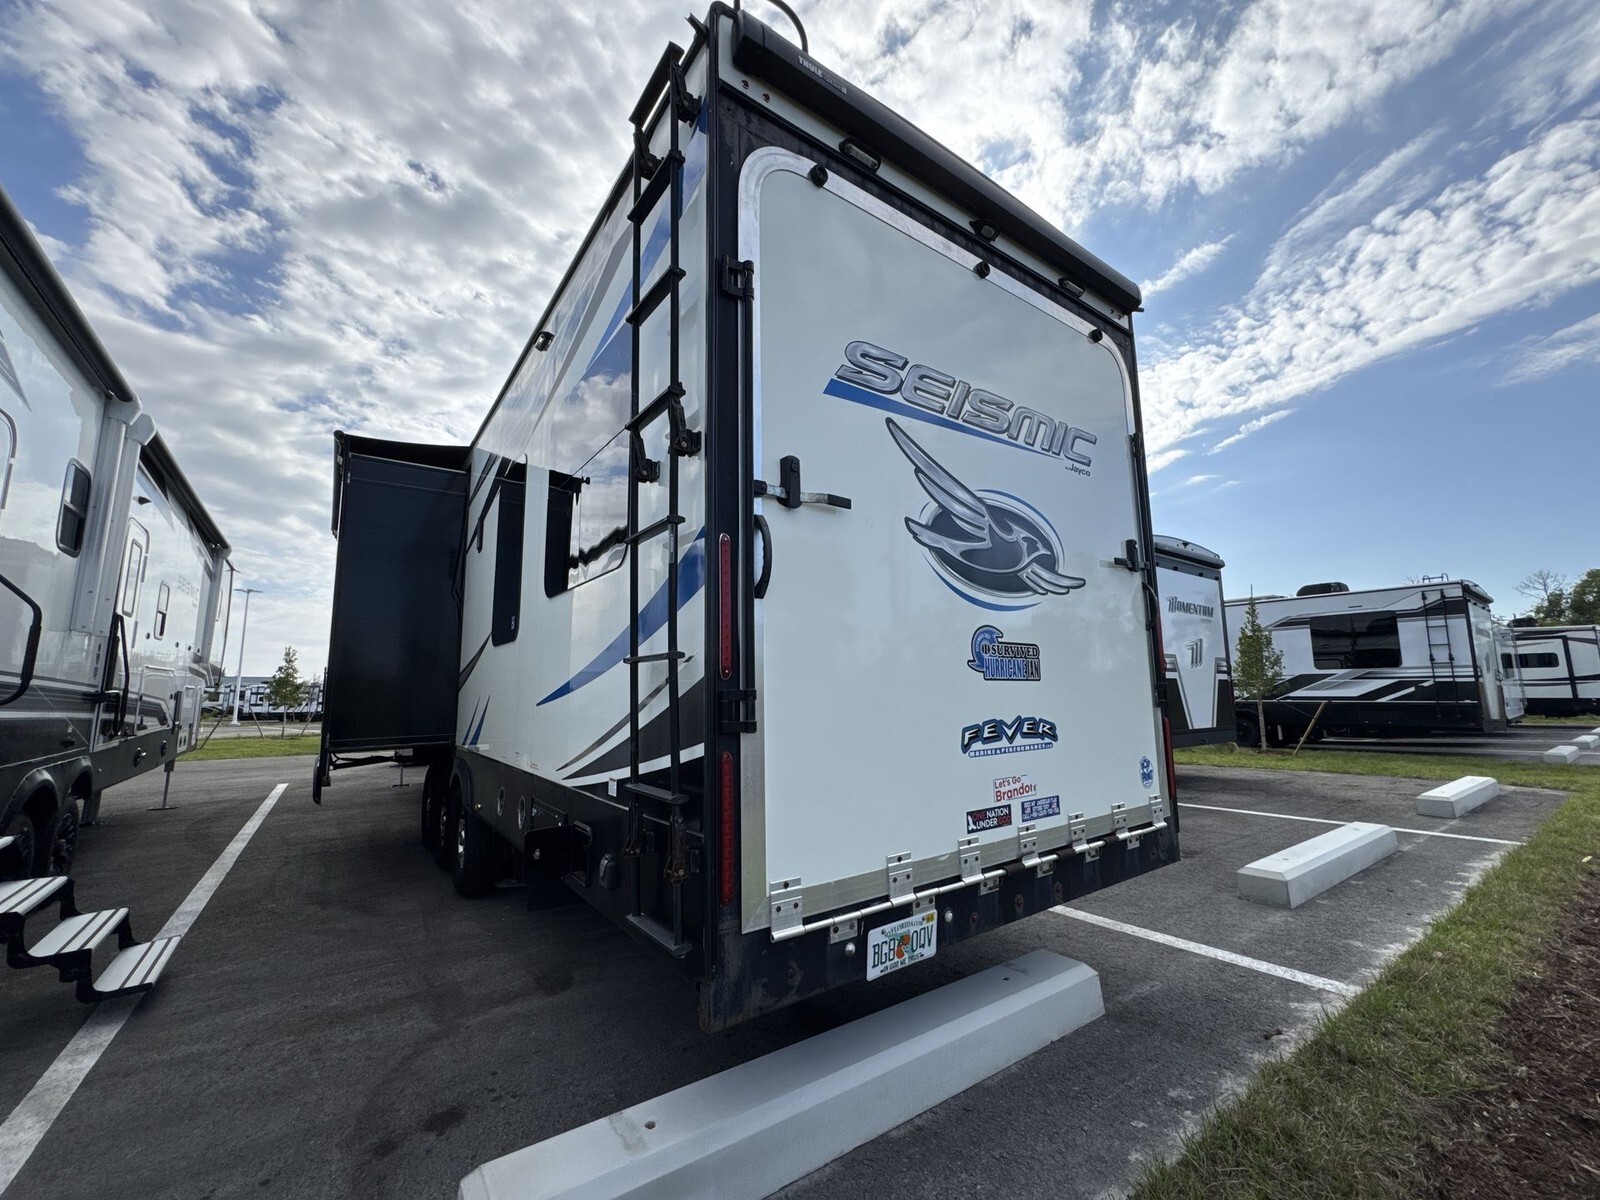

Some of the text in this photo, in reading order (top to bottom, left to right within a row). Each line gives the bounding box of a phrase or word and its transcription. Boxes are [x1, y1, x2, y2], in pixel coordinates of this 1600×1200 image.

[798, 56, 823, 78] THULE
[834, 340, 1098, 467] SEISMIC
[1069, 463, 1091, 477] Jayco
[1166, 596, 1214, 618] MOMENTUM
[991, 644, 1039, 657] SURVIVED
[984, 657, 1041, 679] HURRICANE IAN
[961, 716, 1058, 752] FEVER
[994, 775, 1022, 790] Let's Go
[972, 809, 986, 821] ONE
[986, 806, 1009, 818] NATION
[976, 815, 1011, 830] UNDER GOD
